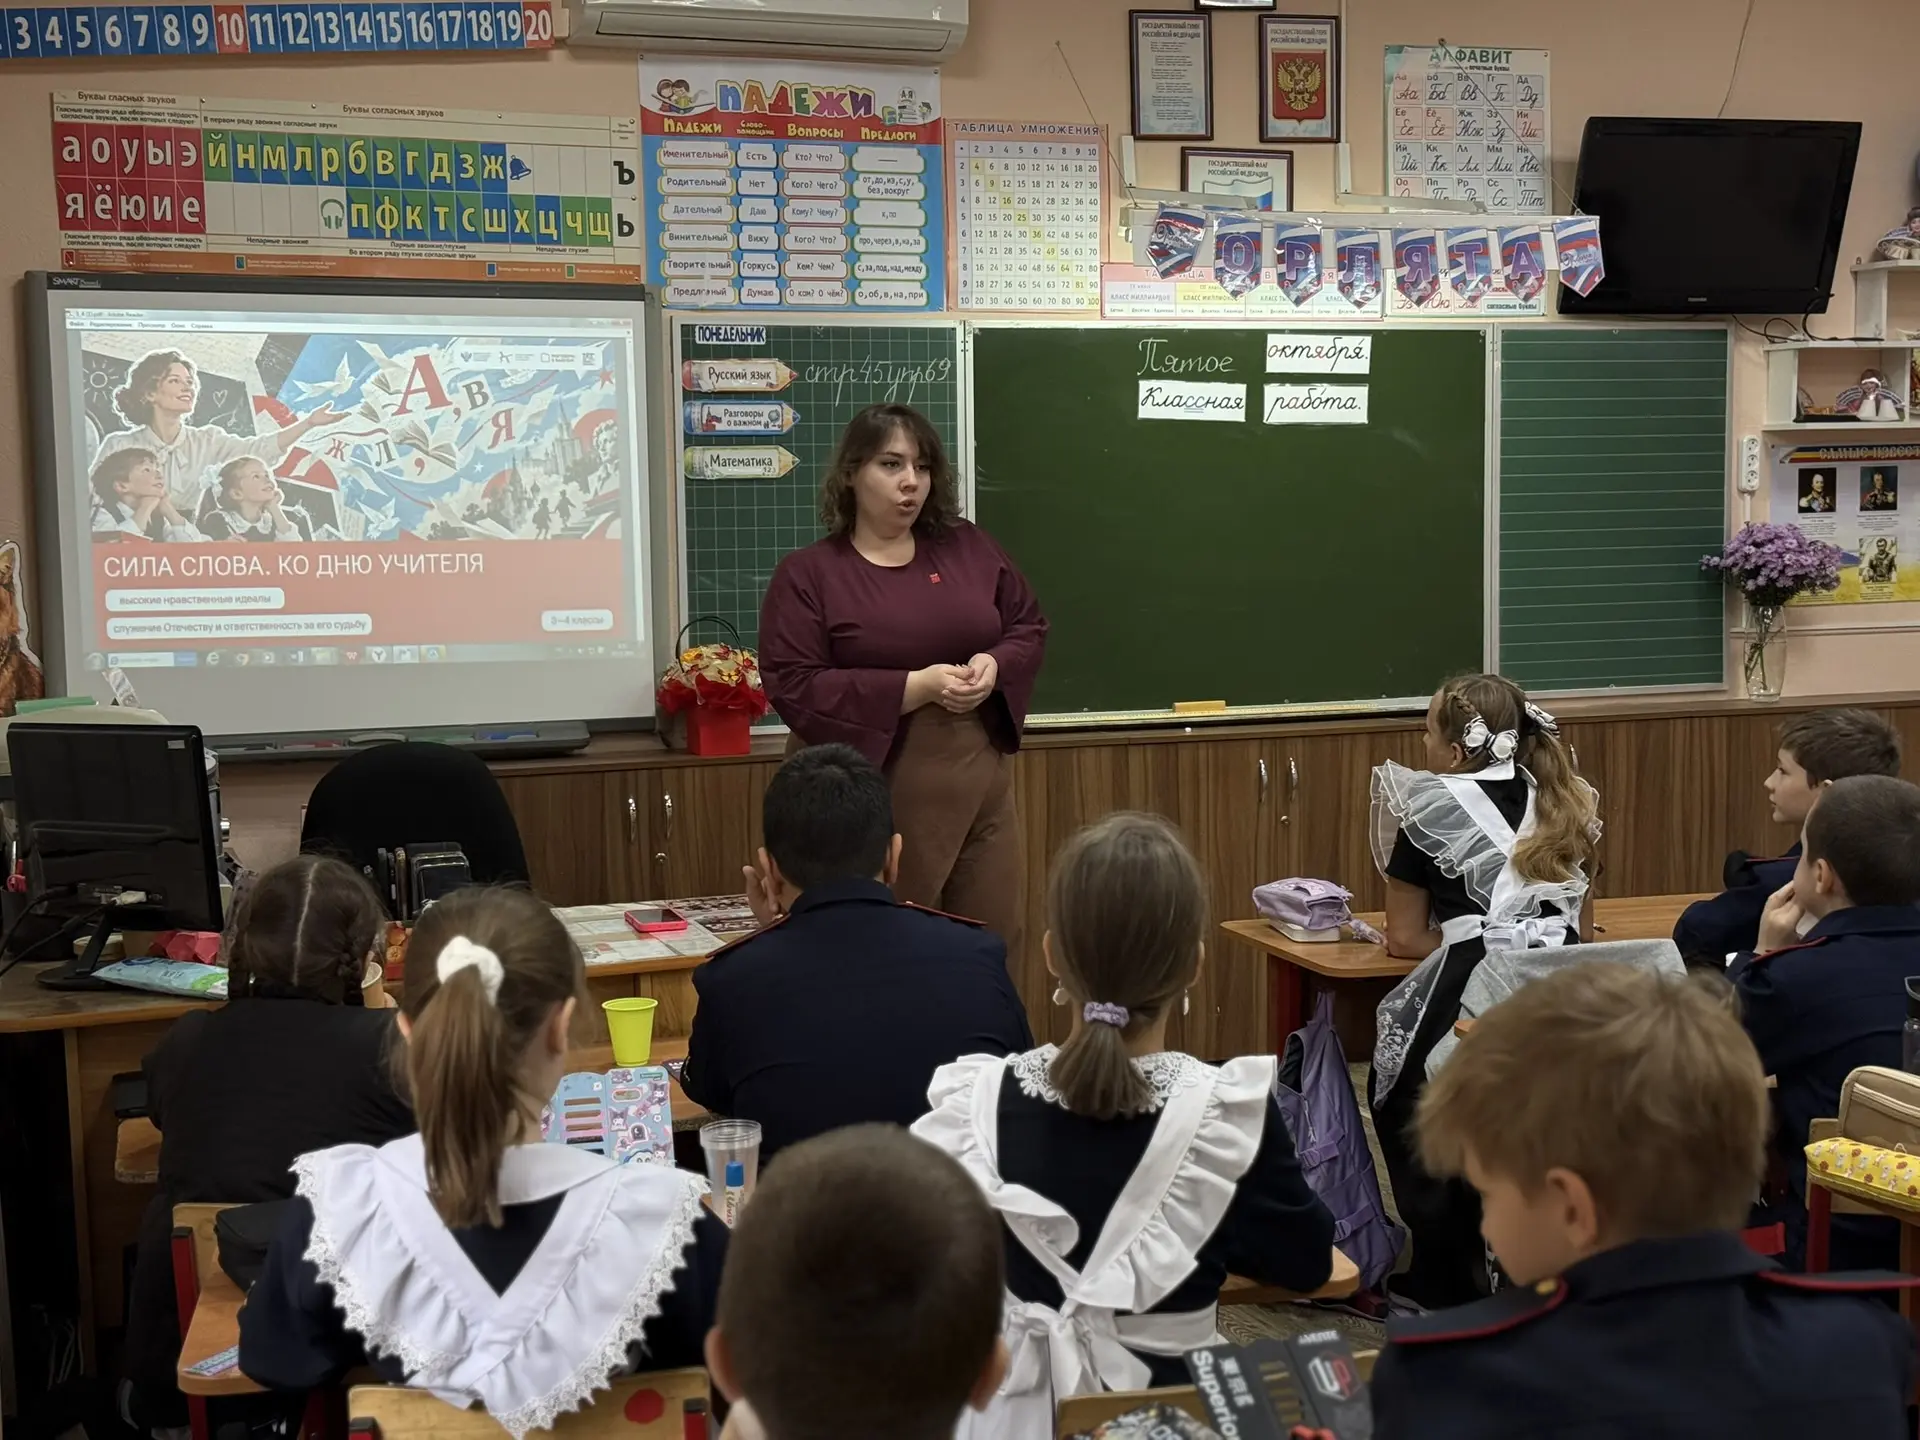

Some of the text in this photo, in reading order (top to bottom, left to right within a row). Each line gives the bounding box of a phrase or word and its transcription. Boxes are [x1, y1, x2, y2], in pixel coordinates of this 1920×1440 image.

[14, 9, 551, 50] 3 4 5 6 7 8 9 10 11 12 13 14 15 16 17 18 19 20
[78, 91, 176, 106] Буквы гласных звуков
[717, 81, 874, 118] ПАДЕЖИ
[343, 104, 444, 118] Буквы согласных звуков
[210, 117, 235, 125] первом
[283, 120, 317, 128] согласные
[955, 122, 1099, 136] ТАБЛИЦА УМНОЖЕНИЯ
[663, 149, 833, 163] Именительный Есть Кто? Что?
[666, 176, 838, 190] Родительный Нет Кого? Чего?
[673, 205, 838, 219] Дательный Даю Кому? Чему?
[668, 232, 728, 243] Винительный
[747, 234, 769, 245] Вижу
[794, 235, 816, 245] Кого?
[819, 235, 837, 245] Что?
[742, 261, 776, 273] Горжусь
[796, 262, 814, 272] Кем?
[817, 262, 835, 272] Чем?
[53, 277, 79, 286] SMART
[747, 288, 774, 299] Думаю
[960, 297, 1099, 305] 10 20 30 40 50 60 70 80 90 100
[698, 326, 765, 343] ПОНЕДЕЛЬНИК
[1137, 337, 1237, 375] Пятое
[708, 367, 772, 382] Русский язык
[1141, 386, 1244, 409] Классная
[724, 409, 764, 420] Разговоры
[733, 419, 762, 427] важном
[710, 454, 773, 468] Математика
[103, 553, 484, 578] СИЛА СЛОВА. КО ДНЮ УЧИТЕЛЯ
[119, 593, 271, 606] высокие нравственные идеалы
[113, 618, 367, 635] служение Отечеству и ответственность за его судьбу
[1192, 1350, 1241, 1440] Superio
